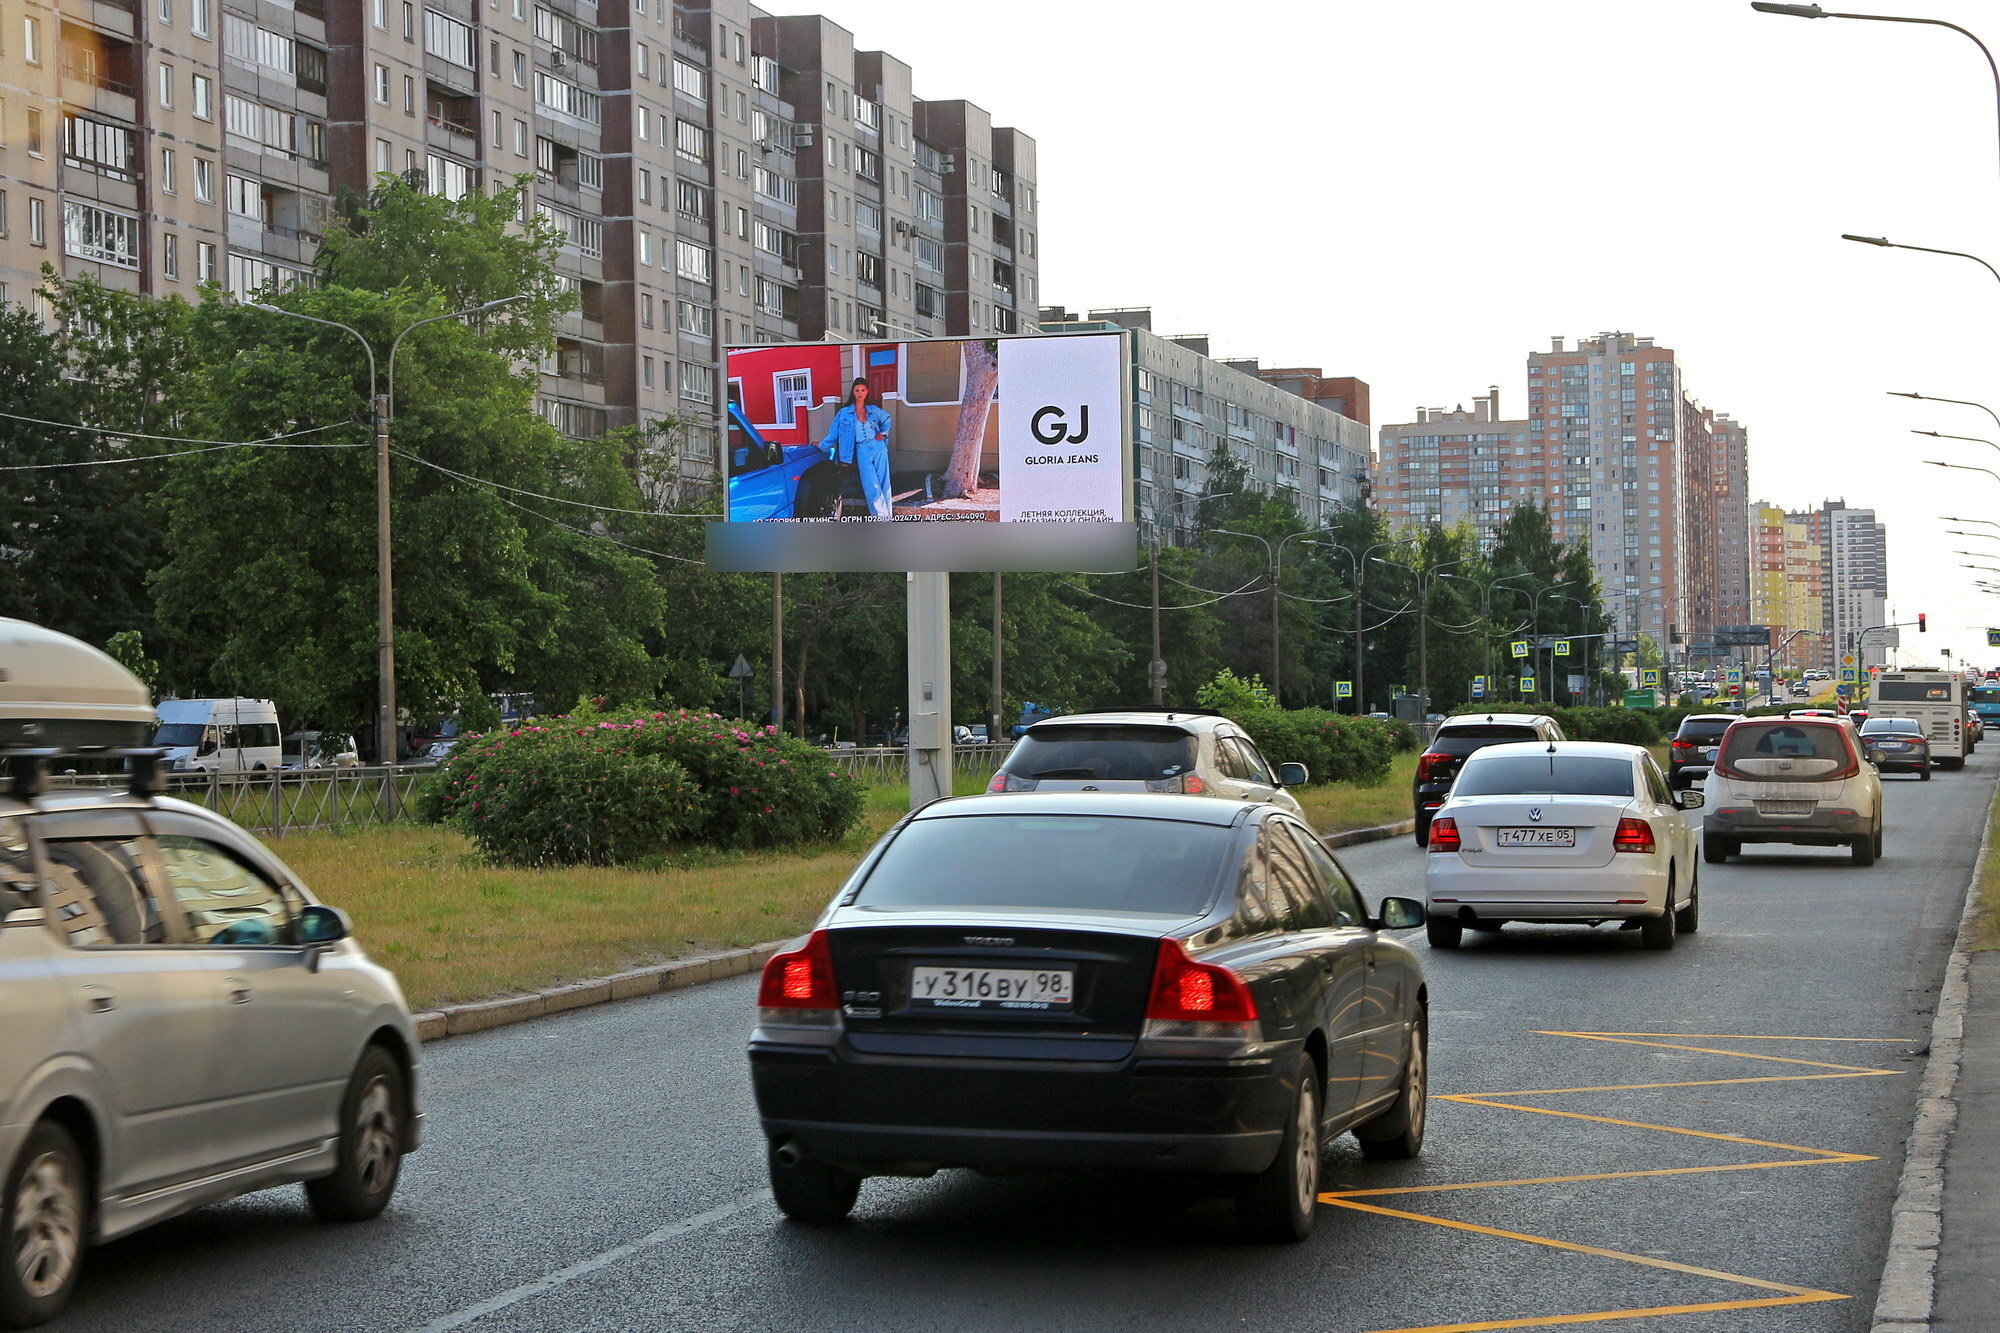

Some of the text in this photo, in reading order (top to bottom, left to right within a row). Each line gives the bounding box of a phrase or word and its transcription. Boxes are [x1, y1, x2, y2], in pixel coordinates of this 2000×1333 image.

[1031, 405, 1088, 445] GJ
[1025, 455, 1099, 465] GLORIA JEANS
[925, 513, 954, 521] АДРЕС:
[956, 512, 987, 521] 344090,
[1020, 510, 1053, 518] ЛЕТНЯЯ
[1035, 972, 1060, 993] 98
